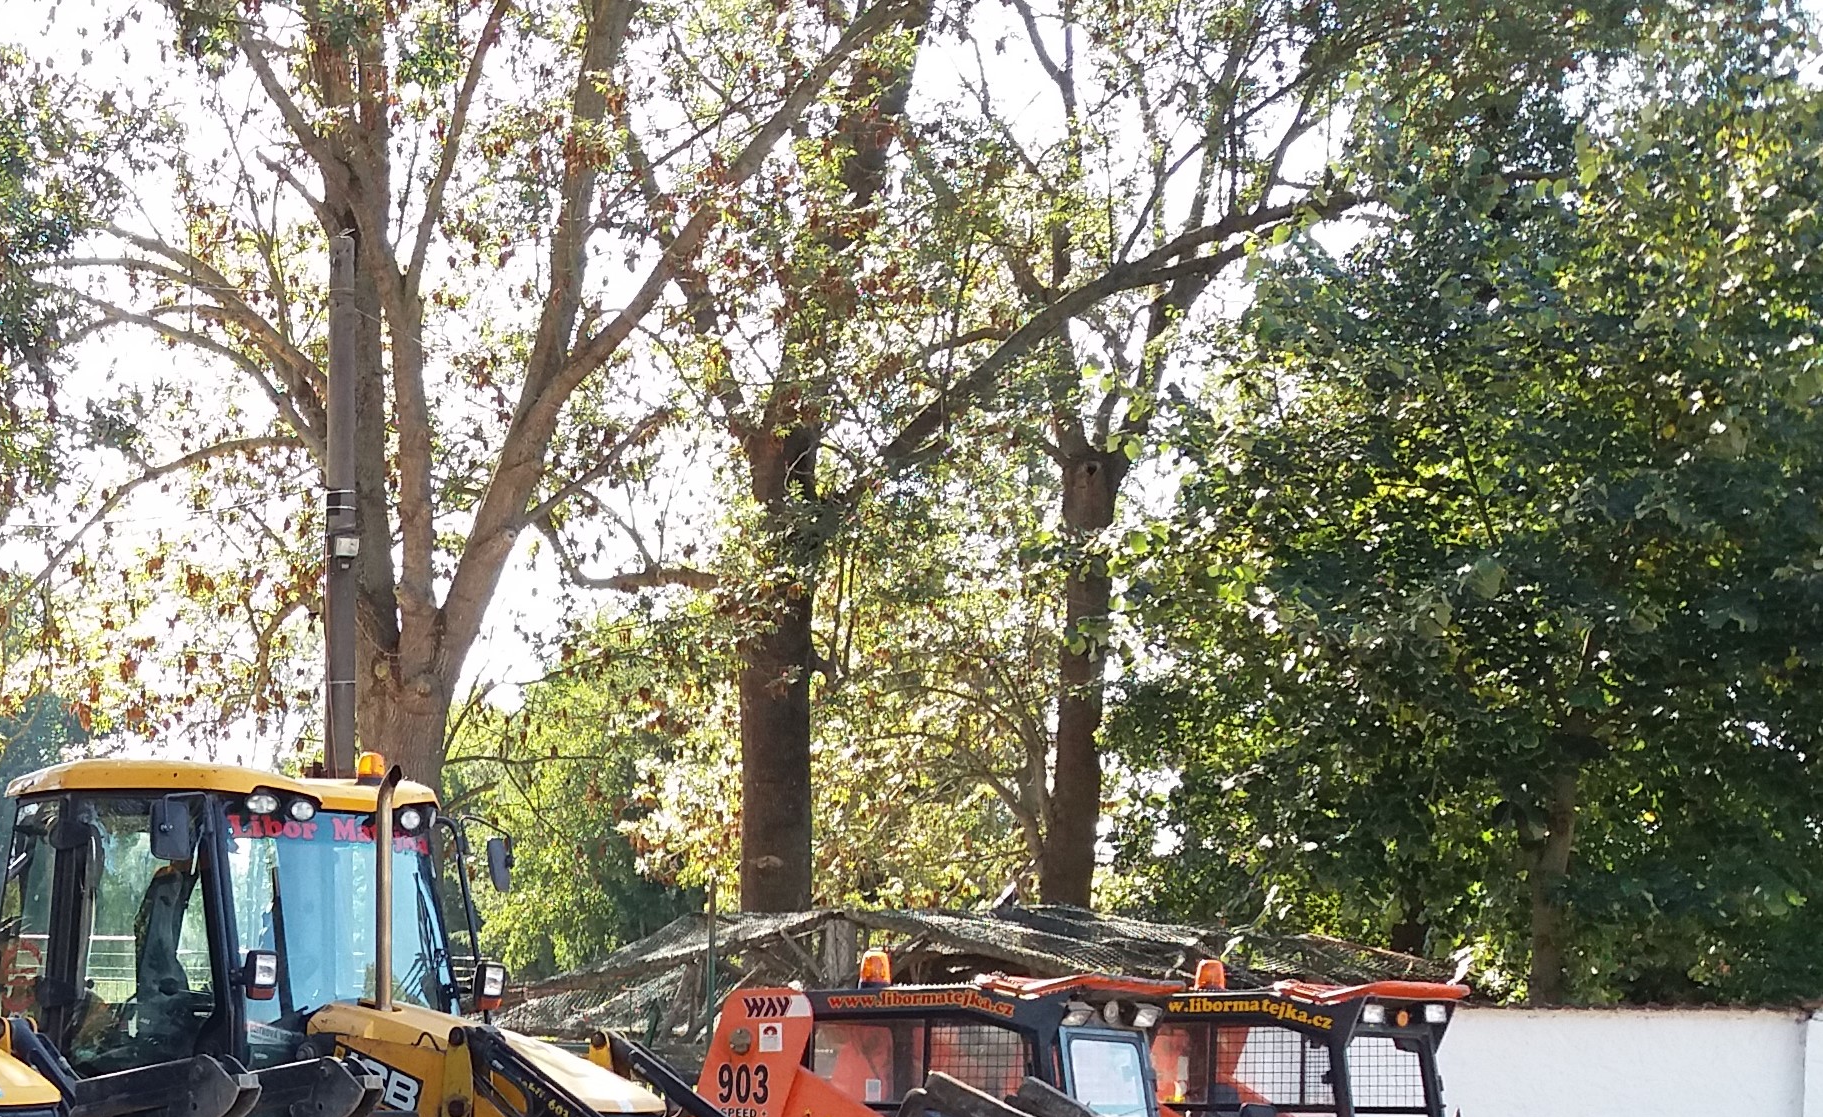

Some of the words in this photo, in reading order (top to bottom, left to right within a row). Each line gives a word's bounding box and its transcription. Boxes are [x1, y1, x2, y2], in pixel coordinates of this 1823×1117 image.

[227, 814, 318, 840] Libor
[743, 996, 791, 1018] WAY
[828, 990, 1014, 1018] www.libormatejka.cz
[718, 1063, 769, 1105] 903
